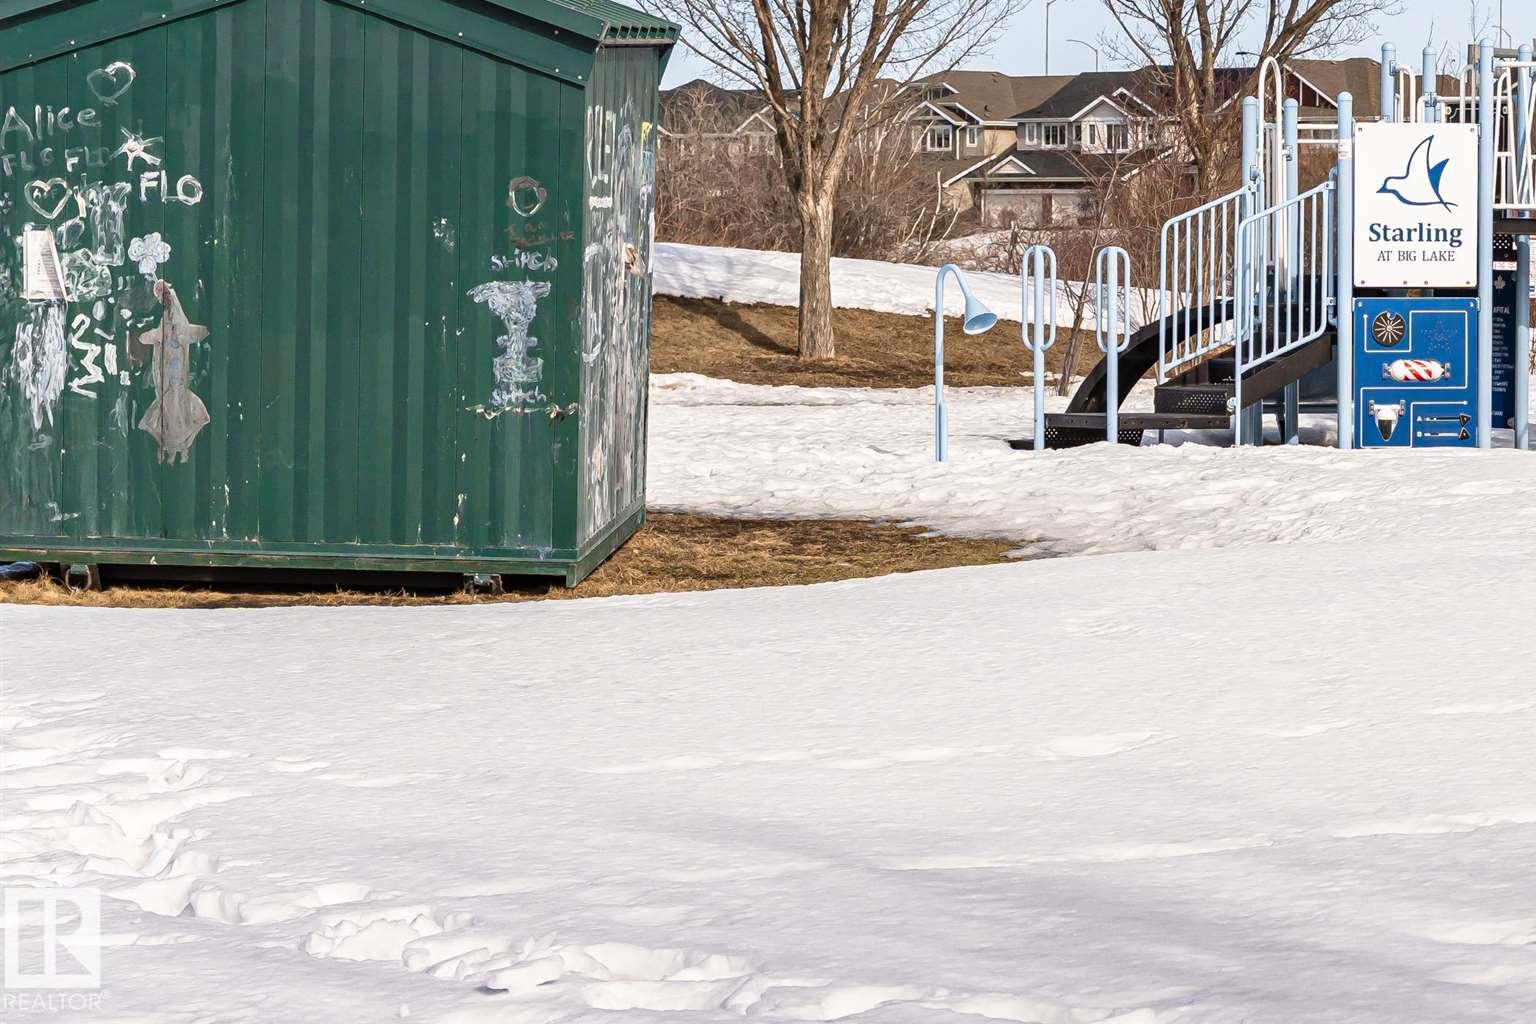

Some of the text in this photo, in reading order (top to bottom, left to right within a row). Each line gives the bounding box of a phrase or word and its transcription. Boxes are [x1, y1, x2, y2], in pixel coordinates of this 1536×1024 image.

[0, 104, 101, 150] Alice
[140, 170, 204, 206] FLO
[1368, 222, 1463, 248] Starling
[1377, 250, 1456, 262] AT BIG LAKE
